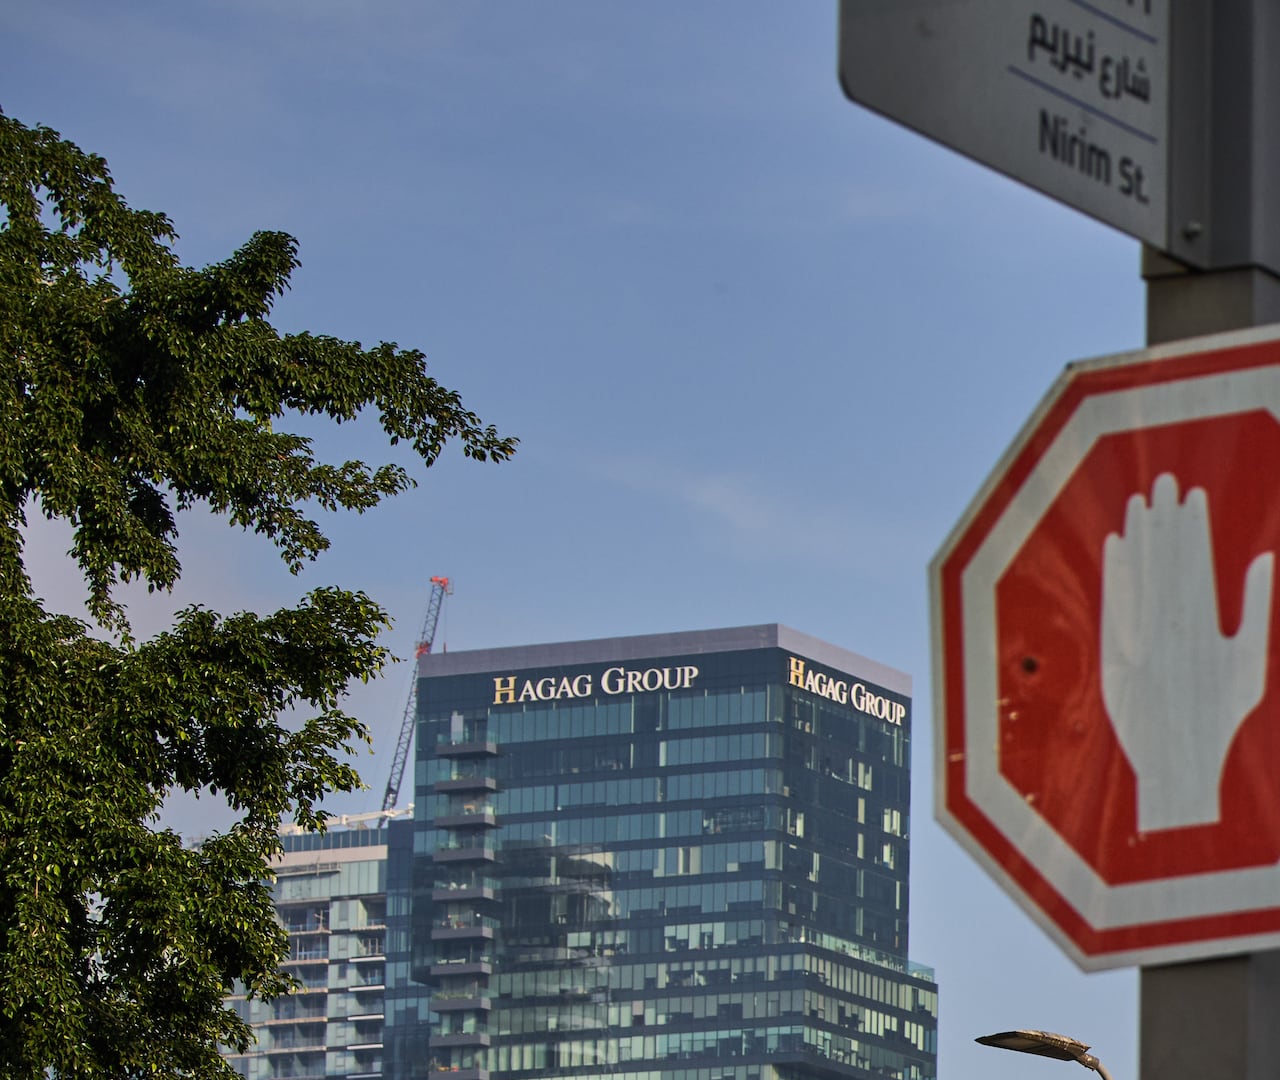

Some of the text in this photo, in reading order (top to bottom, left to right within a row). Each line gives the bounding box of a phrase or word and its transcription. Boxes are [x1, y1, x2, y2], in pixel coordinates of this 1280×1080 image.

[1099, 57, 1151, 103] شارع
[1038, 109, 1149, 204] Nirim St.
